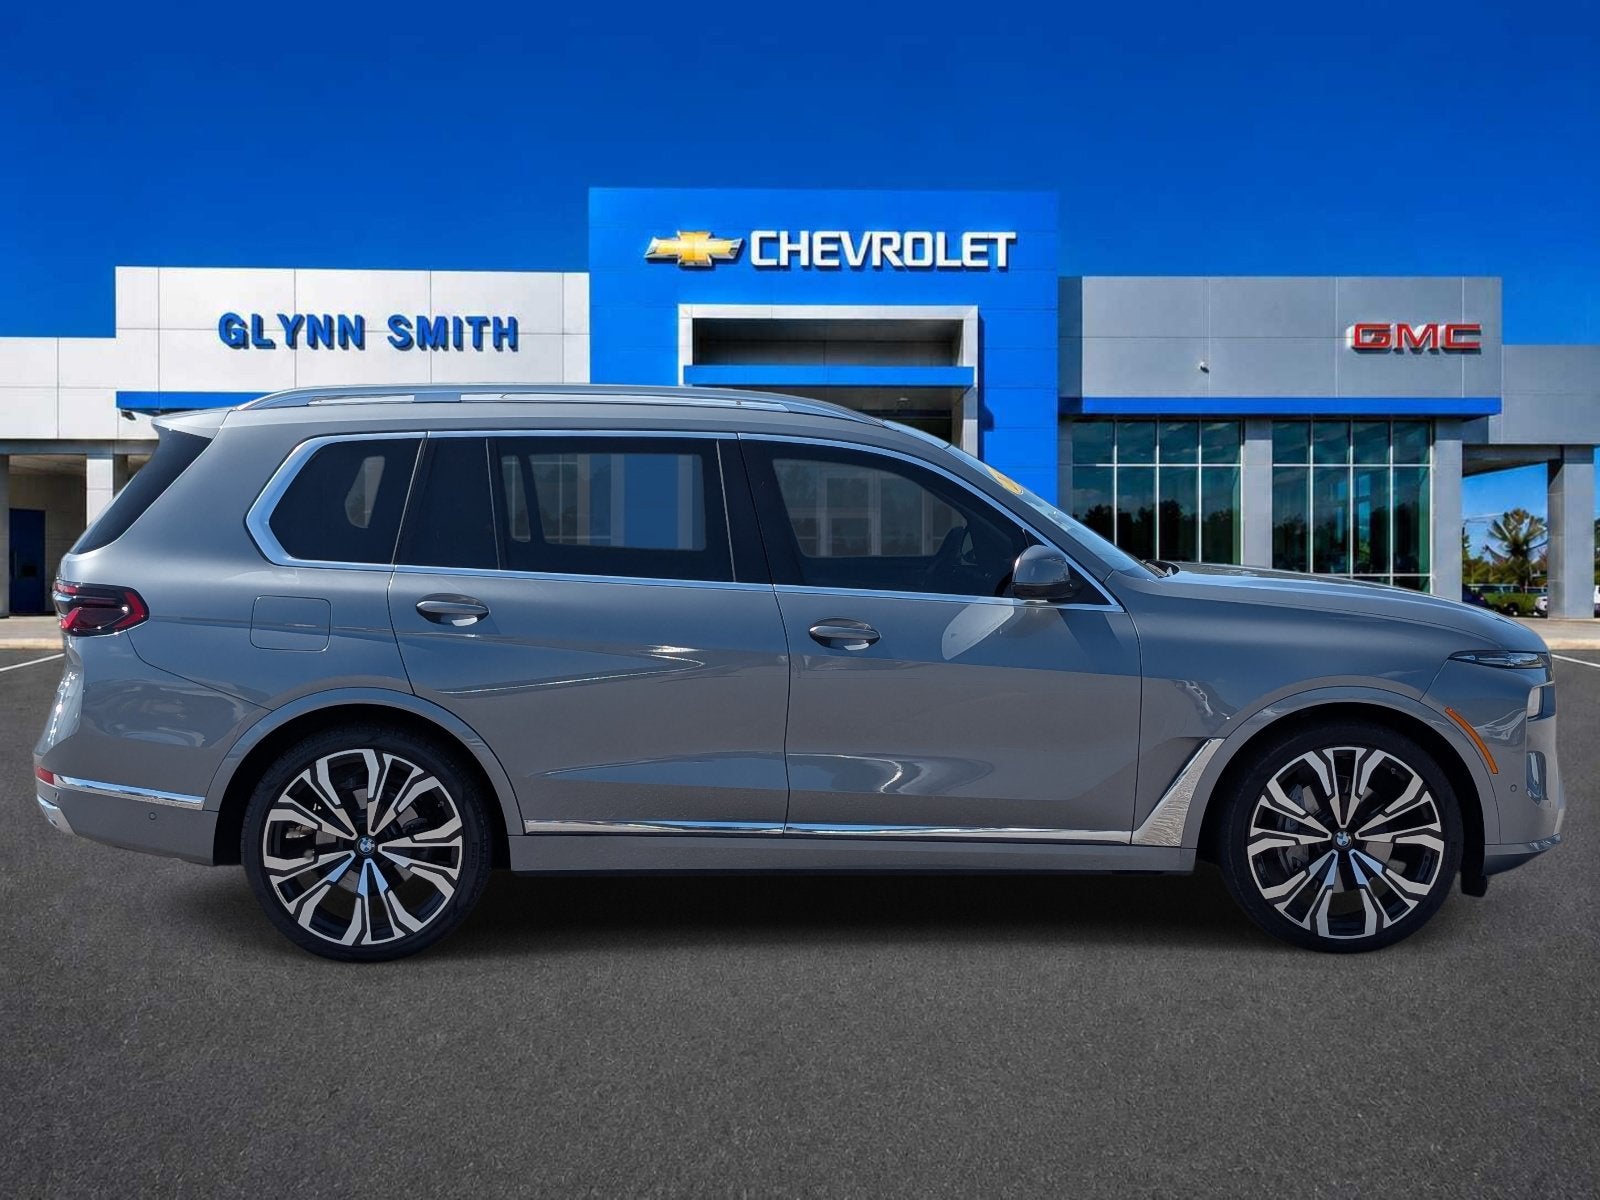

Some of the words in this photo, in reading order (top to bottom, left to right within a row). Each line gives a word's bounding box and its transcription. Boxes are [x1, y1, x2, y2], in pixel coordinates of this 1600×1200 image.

[750, 230, 1017, 269] CHEVROLET
[218, 312, 367, 350] GLYNN
[387, 313, 519, 351] SMITH
[1352, 323, 1481, 350] GMC
